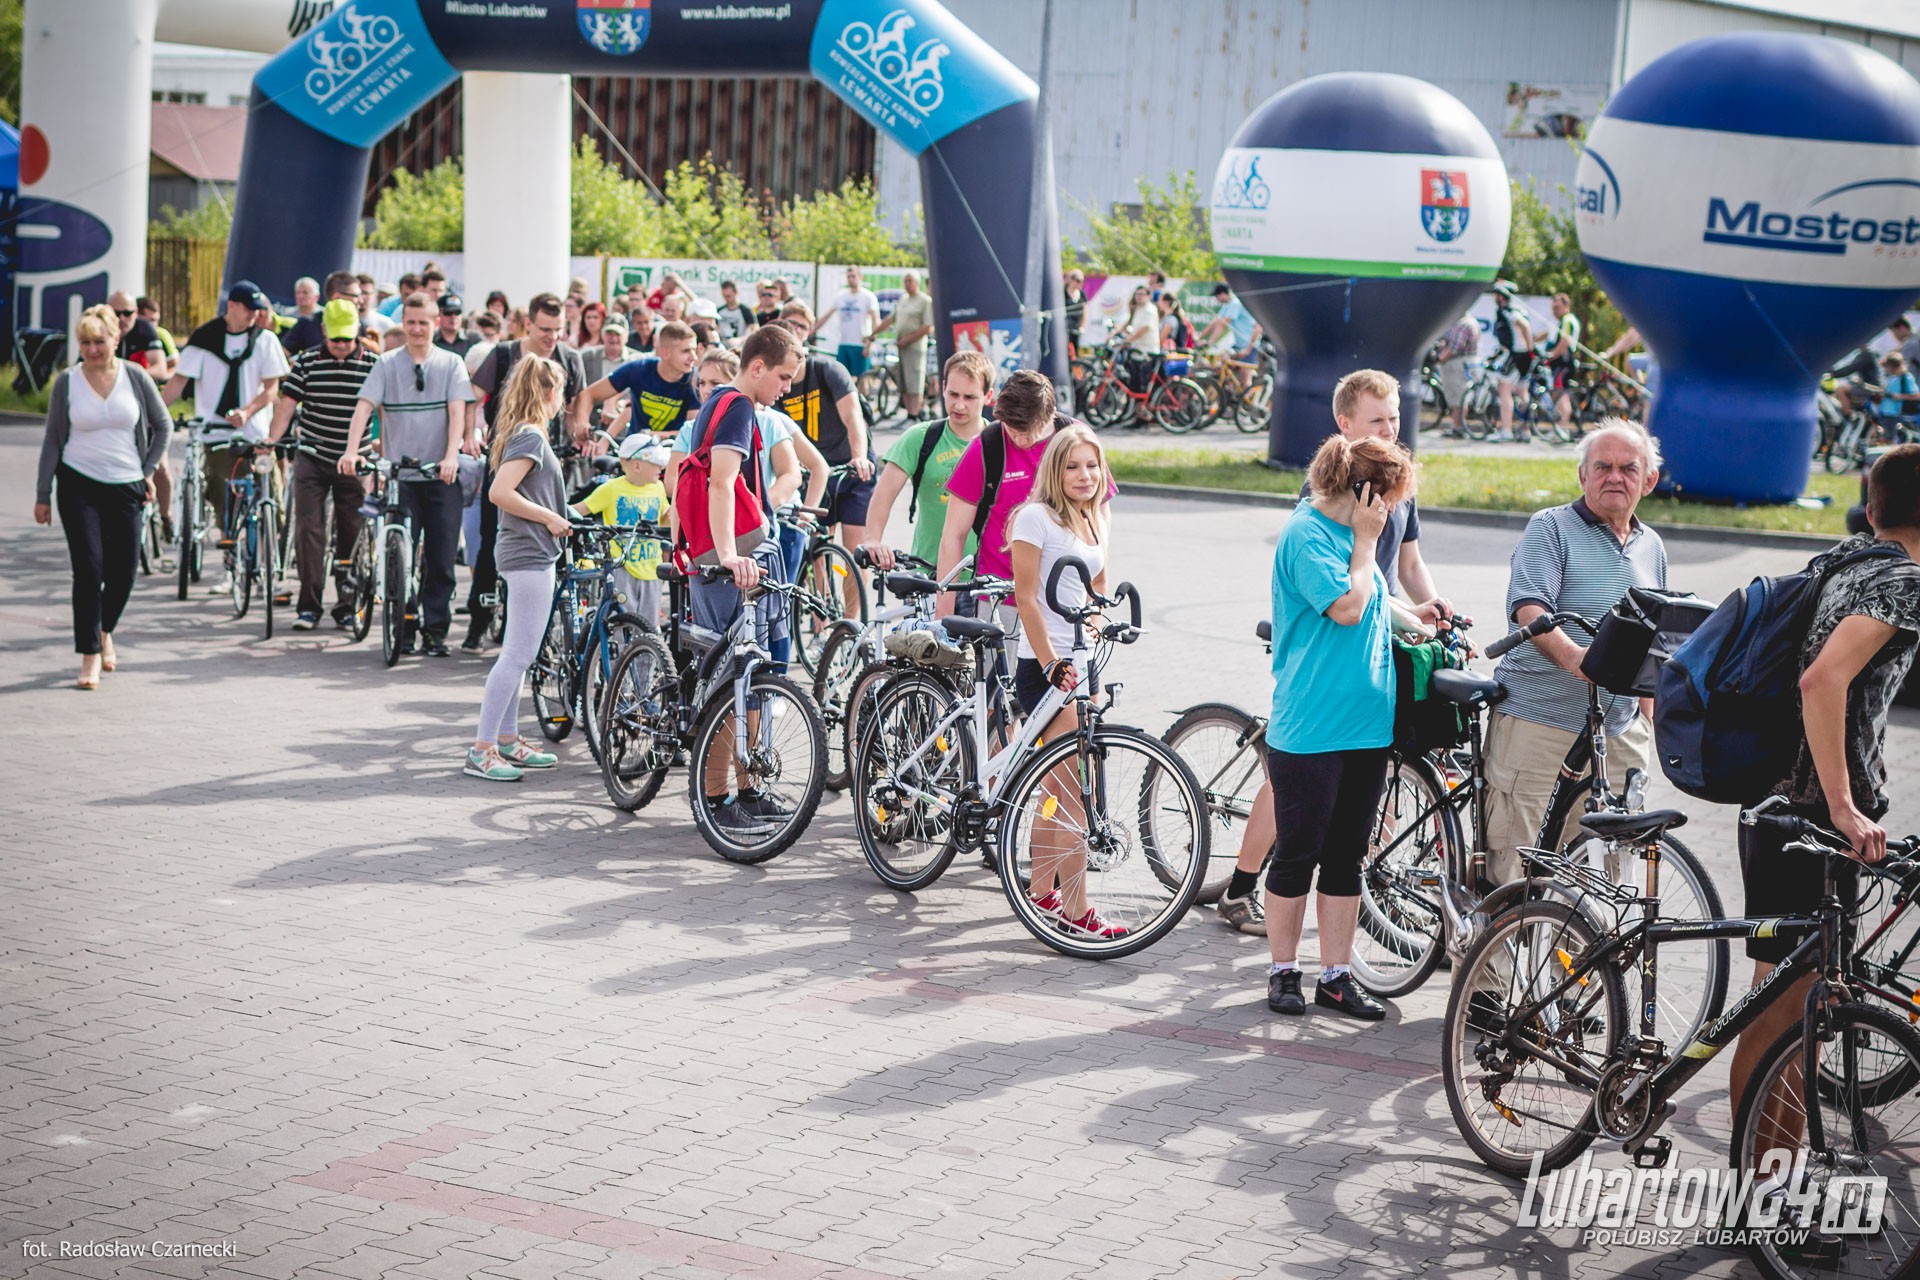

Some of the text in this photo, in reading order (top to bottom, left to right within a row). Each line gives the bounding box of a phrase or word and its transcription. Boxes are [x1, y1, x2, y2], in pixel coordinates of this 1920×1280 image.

[445, 1, 548, 18] Miasto Lubartów
[680, 3, 791, 21] www.lubartow.pl
[352, 67, 413, 115] LEWARTA
[839, 74, 896, 127] LEWARTA
[1709, 957, 1792, 1038] MERIDA
